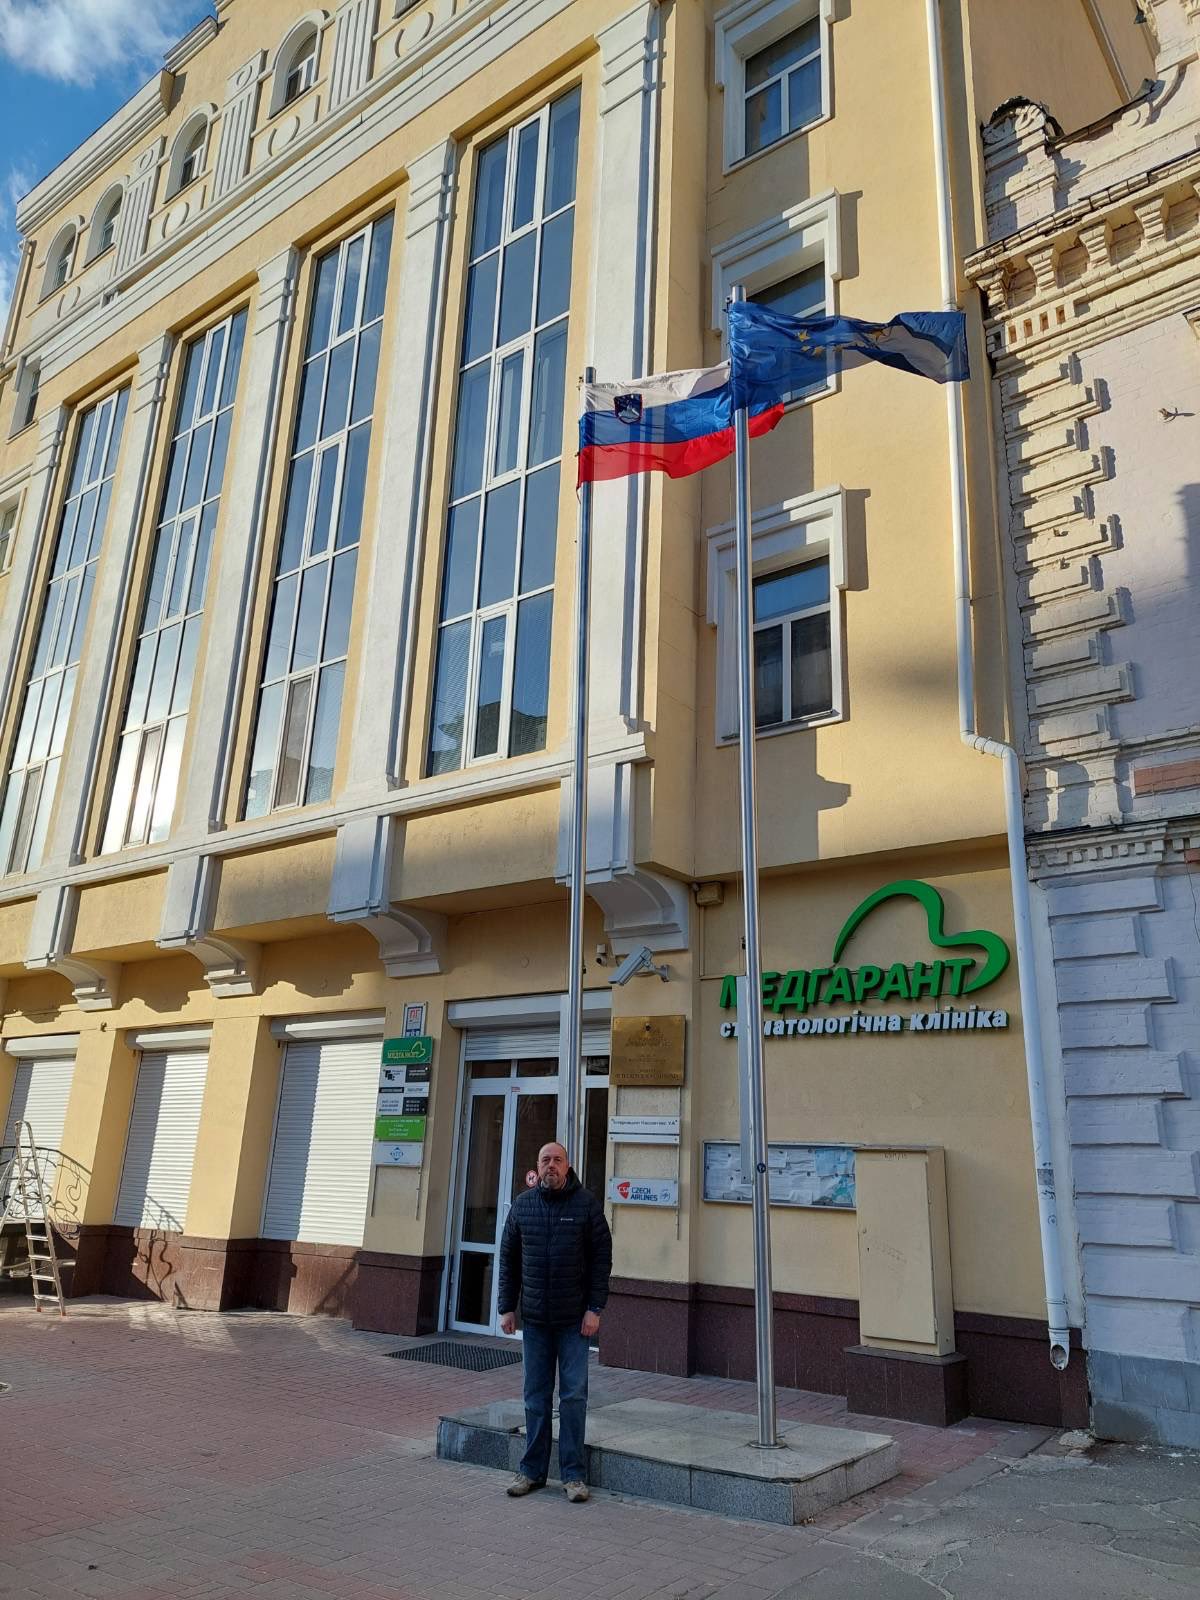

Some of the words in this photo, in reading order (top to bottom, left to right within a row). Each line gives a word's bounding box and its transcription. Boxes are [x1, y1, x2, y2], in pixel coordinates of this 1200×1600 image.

[720, 1009, 904, 1038] статологічна
[910, 1004, 1009, 1031] клініка
[631, 1186, 651, 1194] CZECH
[630, 1193, 658, 1202] AIRLINES
